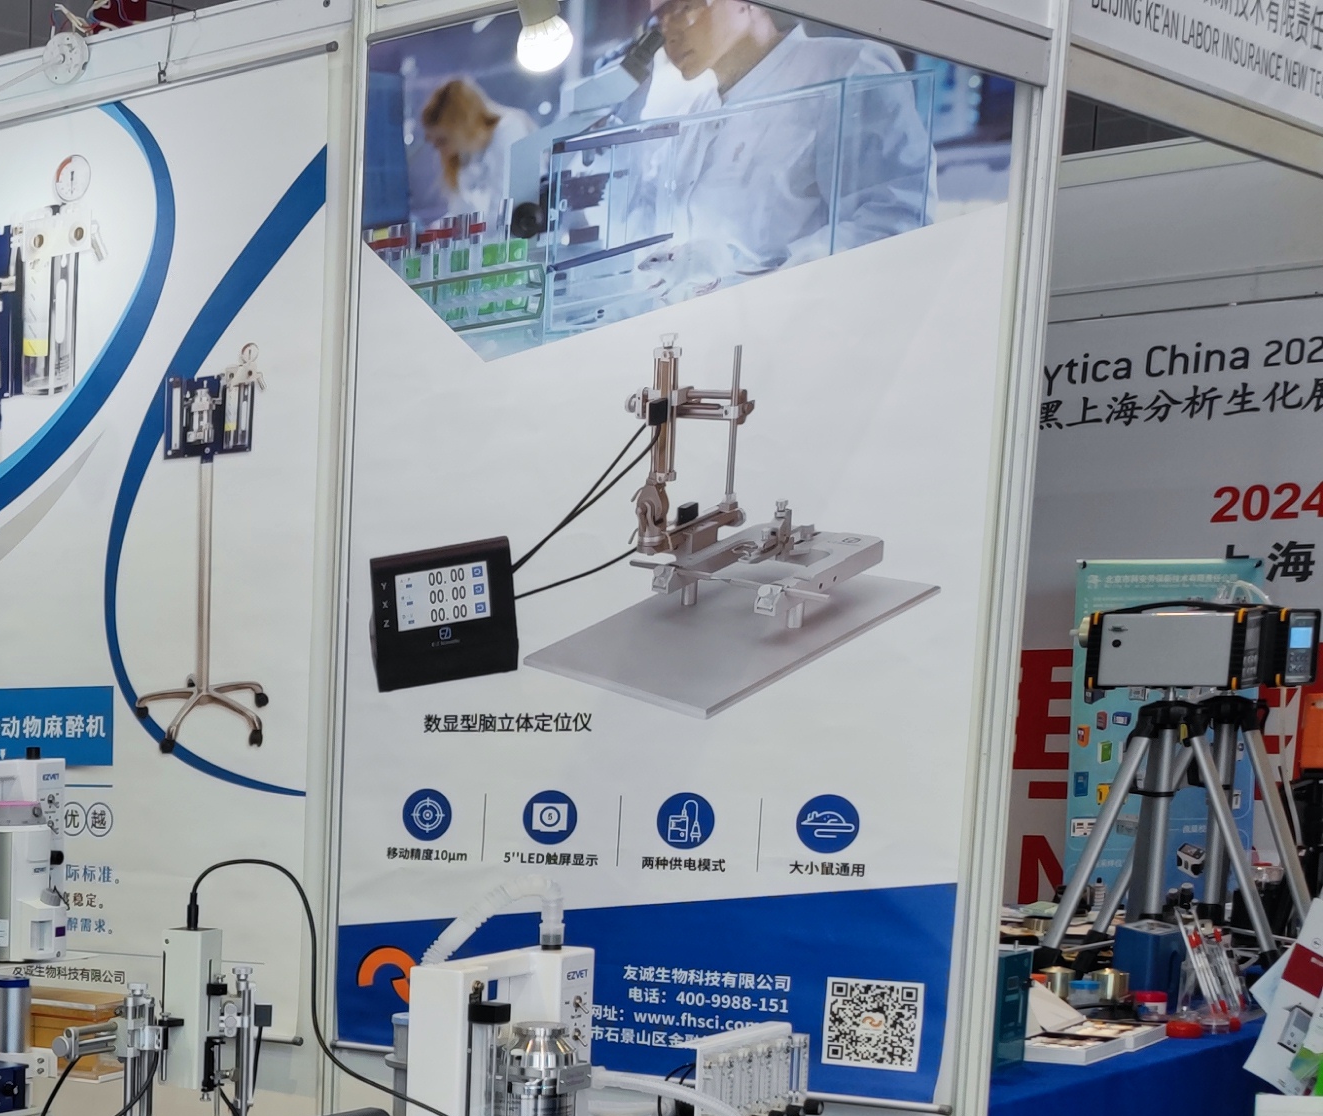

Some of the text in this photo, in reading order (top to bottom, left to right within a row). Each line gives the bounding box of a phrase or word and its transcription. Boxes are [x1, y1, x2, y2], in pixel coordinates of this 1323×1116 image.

[1144, 0, 1180, 40] KE'AN
[1181, 15, 1219, 57] LABOR
[1222, 32, 1283, 81] INSURANCE
[1283, 57, 1310, 91] NEW
[1145, 342, 1250, 378] China
[1210, 482, 1323, 524] 2024
[428, 567, 465, 586] 00.00
[429, 585, 466, 604] 00.00
[430, 604, 467, 623] 00.00
[424, 711, 592, 734] 数显型脑立体定位仪
[65, 863, 119, 885] 际标准。
[641, 856, 726, 873] 两种供电模式
[789, 861, 866, 877] 大小鼠通用
[566, 969, 589, 981] EZVET
[622, 965, 791, 992] 友诚生物科技有限公司
